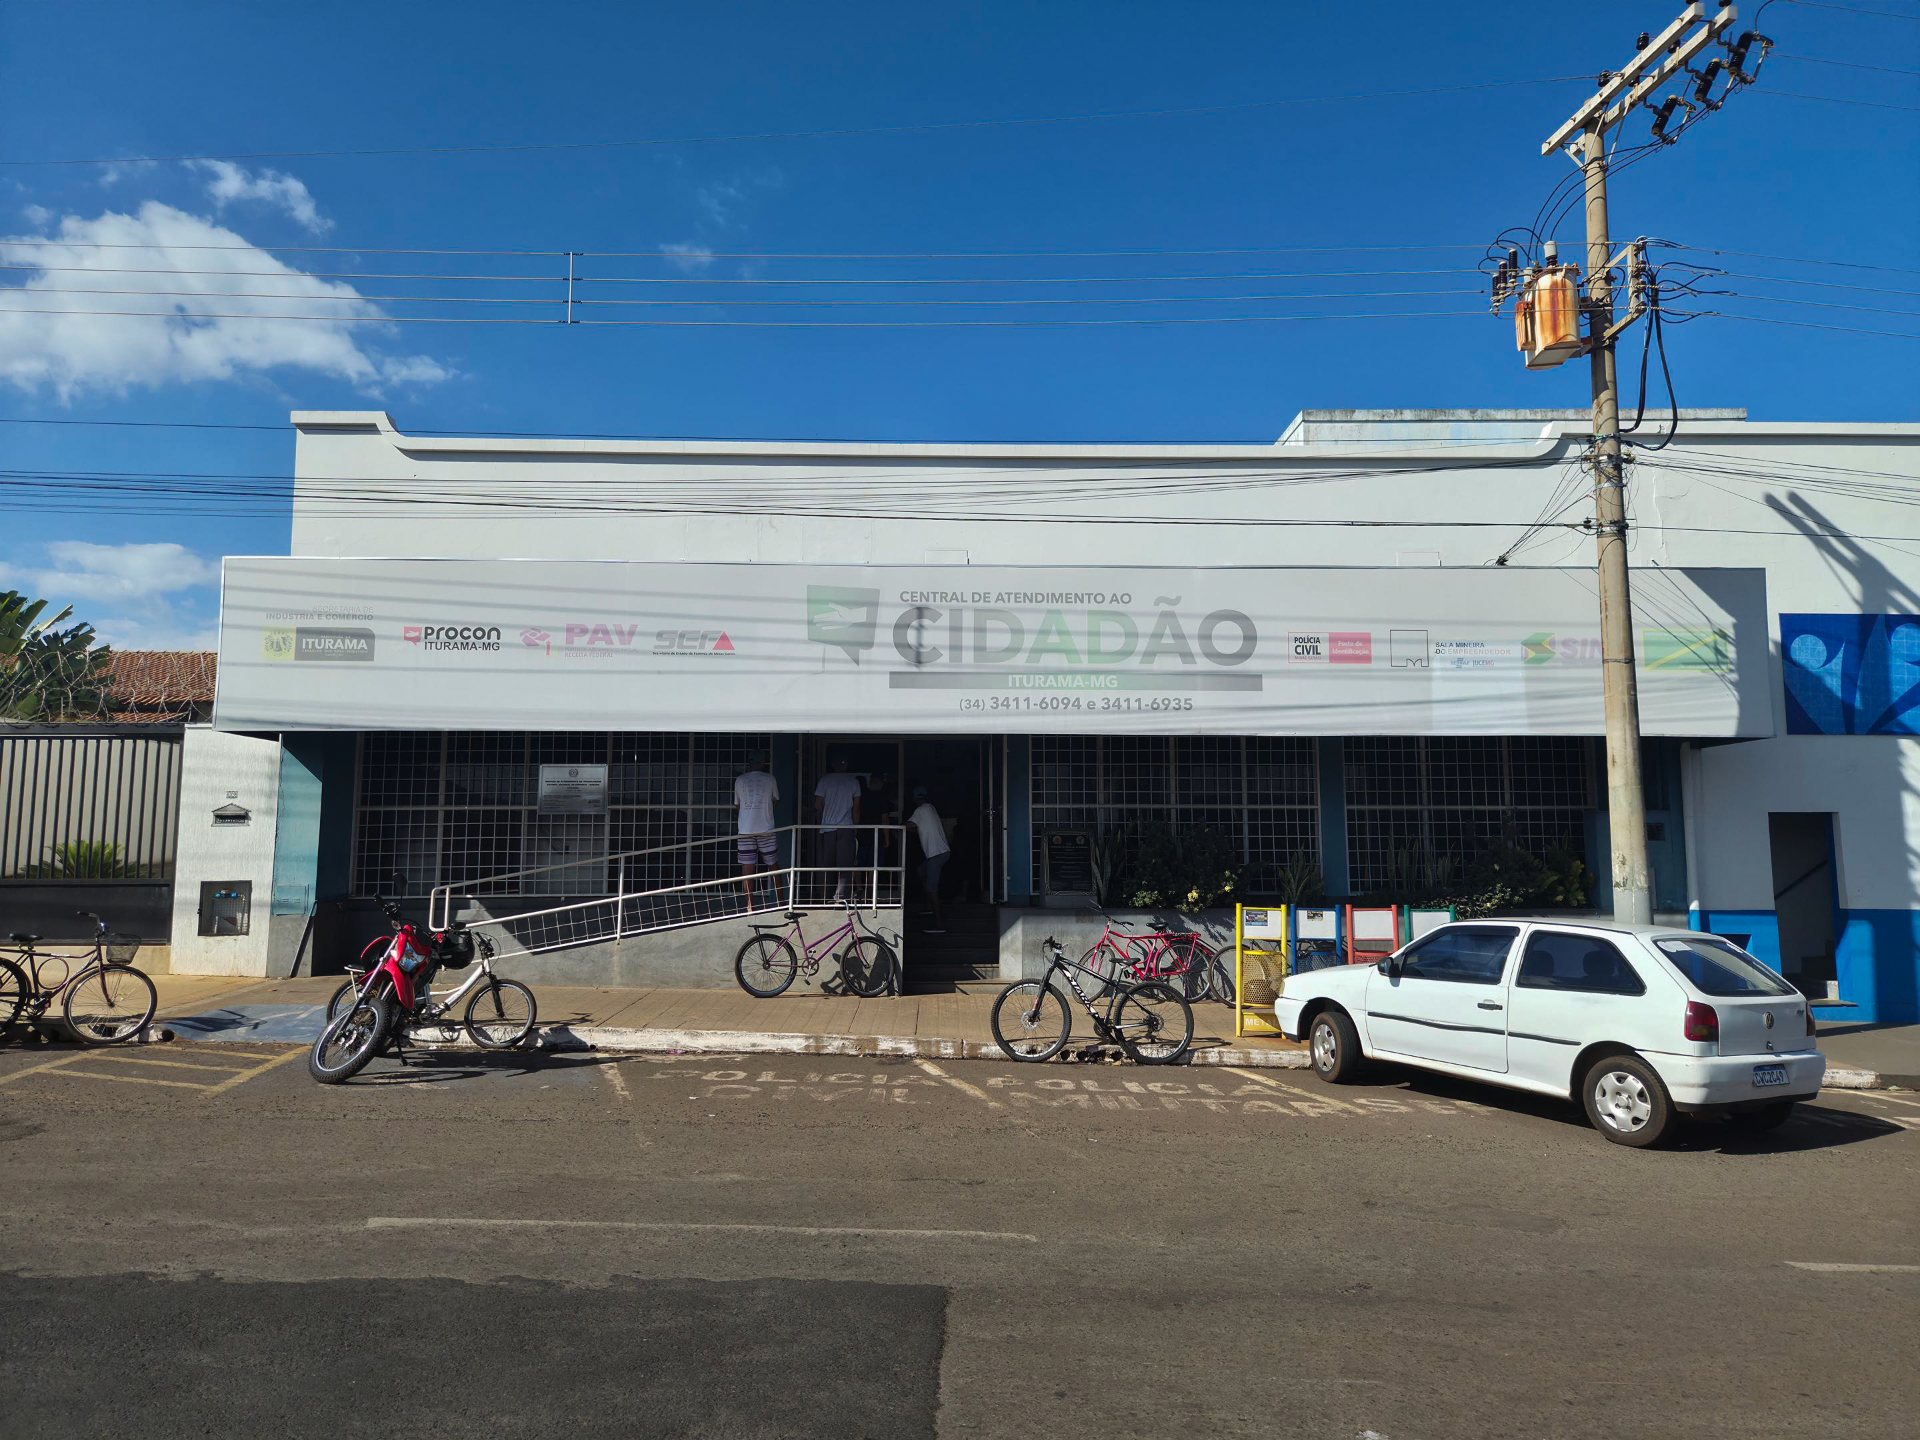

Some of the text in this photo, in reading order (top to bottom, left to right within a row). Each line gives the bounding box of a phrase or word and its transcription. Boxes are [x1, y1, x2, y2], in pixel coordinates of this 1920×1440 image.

[899, 590, 1132, 605] CENTRAL DE ATENDIMENTO AO
[312, 606, 374, 614] SECRETARIA DE
[565, 623, 638, 646] PAV
[892, 595, 1258, 667] CIDADÃO
[302, 638, 368, 649] ITURAMA
[424, 641, 500, 651] ITURAMA-MG
[1294, 635, 1320, 644] POLÍCIA
[1294, 644, 1321, 655] CIVIL
[1559, 637, 1602, 659] SIN
[1008, 674, 1118, 689] ITURAMA-MG
[959, 696, 1194, 712] (34) 3411-6094 e 3411-6935
[1245, 1018, 1278, 1026] METAL
